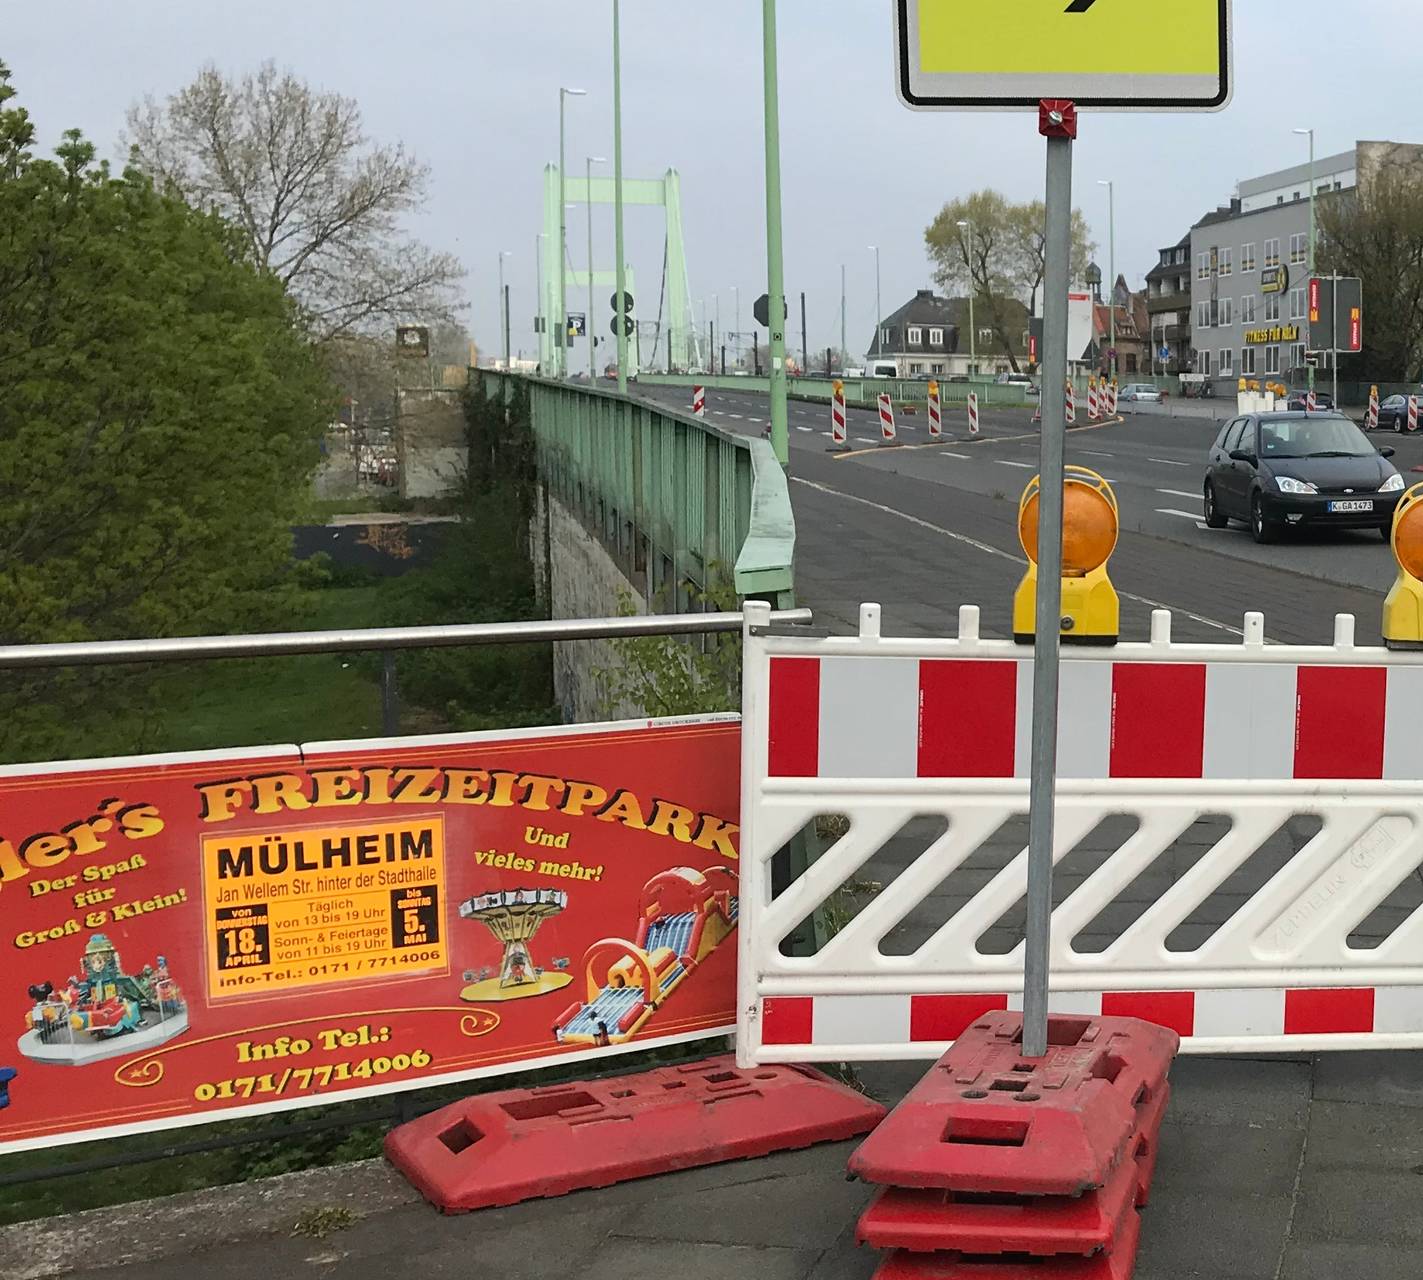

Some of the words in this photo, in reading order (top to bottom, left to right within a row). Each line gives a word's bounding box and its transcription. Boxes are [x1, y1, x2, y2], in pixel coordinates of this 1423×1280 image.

[194, 765, 740, 859] FREIZEITPARK
[523, 826, 570, 848] Und
[217, 828, 433, 879] MÜLHEIM
[474, 849, 536, 872] vieles
[538, 858, 604, 882] mehr!
[30, 874, 79, 896] Der
[82, 853, 148, 881] Spaß
[216, 886, 239, 903] Jan
[243, 881, 289, 901] Wellem
[292, 876, 314, 895] Str.
[316, 873, 352, 892] hinter
[355, 873, 375, 888] der
[378, 865, 436, 886] Stadthalle
[74, 887, 117, 908] für
[308, 899, 353, 913] Täglich
[406, 888, 422, 898] bis
[14, 919, 82, 948] Groß
[85, 911, 107, 929] &
[111, 888, 188, 922] Klein!
[231, 908, 252, 918] von
[275, 919, 299, 929] von
[304, 914, 319, 926] 13
[321, 912, 341, 924] bis
[346, 910, 359, 920] 19
[363, 908, 386, 919] Uhr
[403, 908, 426, 934] 5.
[224, 928, 262, 956] 18.
[274, 936, 313, 949] Sonn-
[317, 932, 326, 944] &
[329, 926, 389, 941] Feiertage
[277, 949, 301, 960] von
[305, 945, 319, 957] 11
[323, 943, 342, 955] bis
[347, 940, 360, 951] 19
[364, 938, 387, 949] Uhr
[403, 933, 427, 945] MAI
[225, 954, 263, 967] APRIL
[308, 962, 349, 976] 0171
[366, 950, 441, 969] 7714006
[235, 1036, 311, 1063] Info
[317, 1024, 391, 1051] Tel.:
[193, 1049, 433, 1102] 0171/7714006
